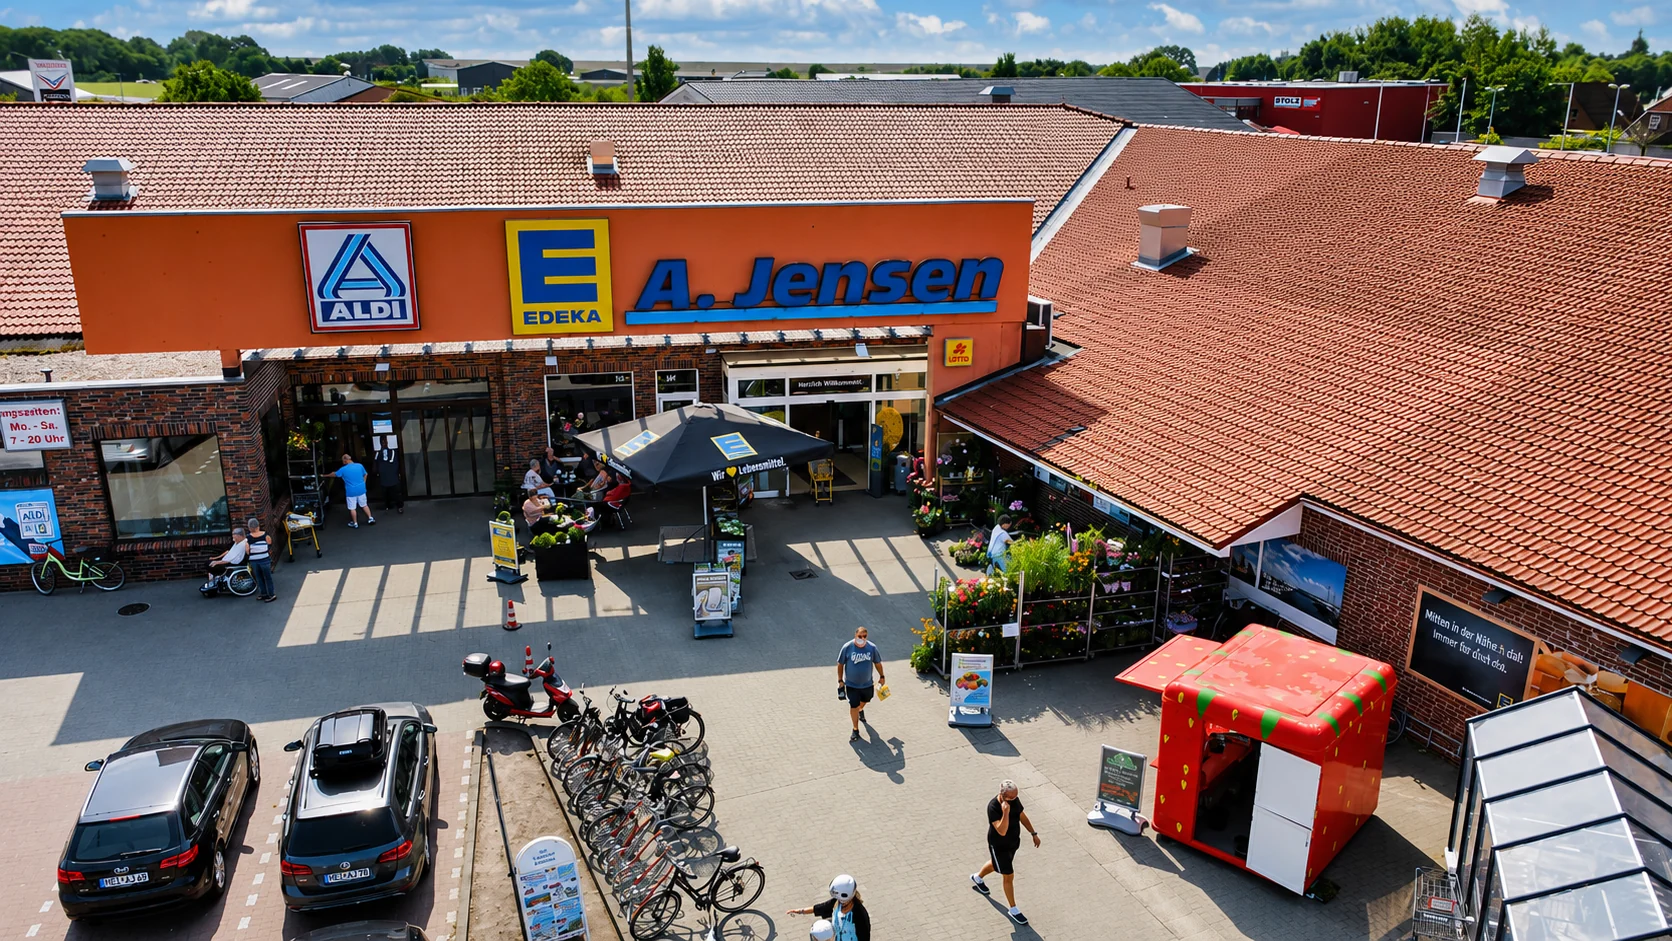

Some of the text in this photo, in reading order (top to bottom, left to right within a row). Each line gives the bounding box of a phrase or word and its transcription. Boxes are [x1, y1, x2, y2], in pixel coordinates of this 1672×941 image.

[634, 256, 1005, 311] A. Jensen
[329, 301, 401, 320] ALDI
[523, 310, 602, 325] EDEKA
[9, 422, 32, 432] Mo.
[10, 436, 17, 445] 7
[27, 435, 42, 444] 20
[44, 434, 65, 443] Uhr
[711, 470, 725, 481] Wir
[1425, 609, 1450, 630] Mitten
[1451, 620, 1460, 634] in
[1460, 626, 1475, 640] der
[1433, 628, 1458, 648] Immer
